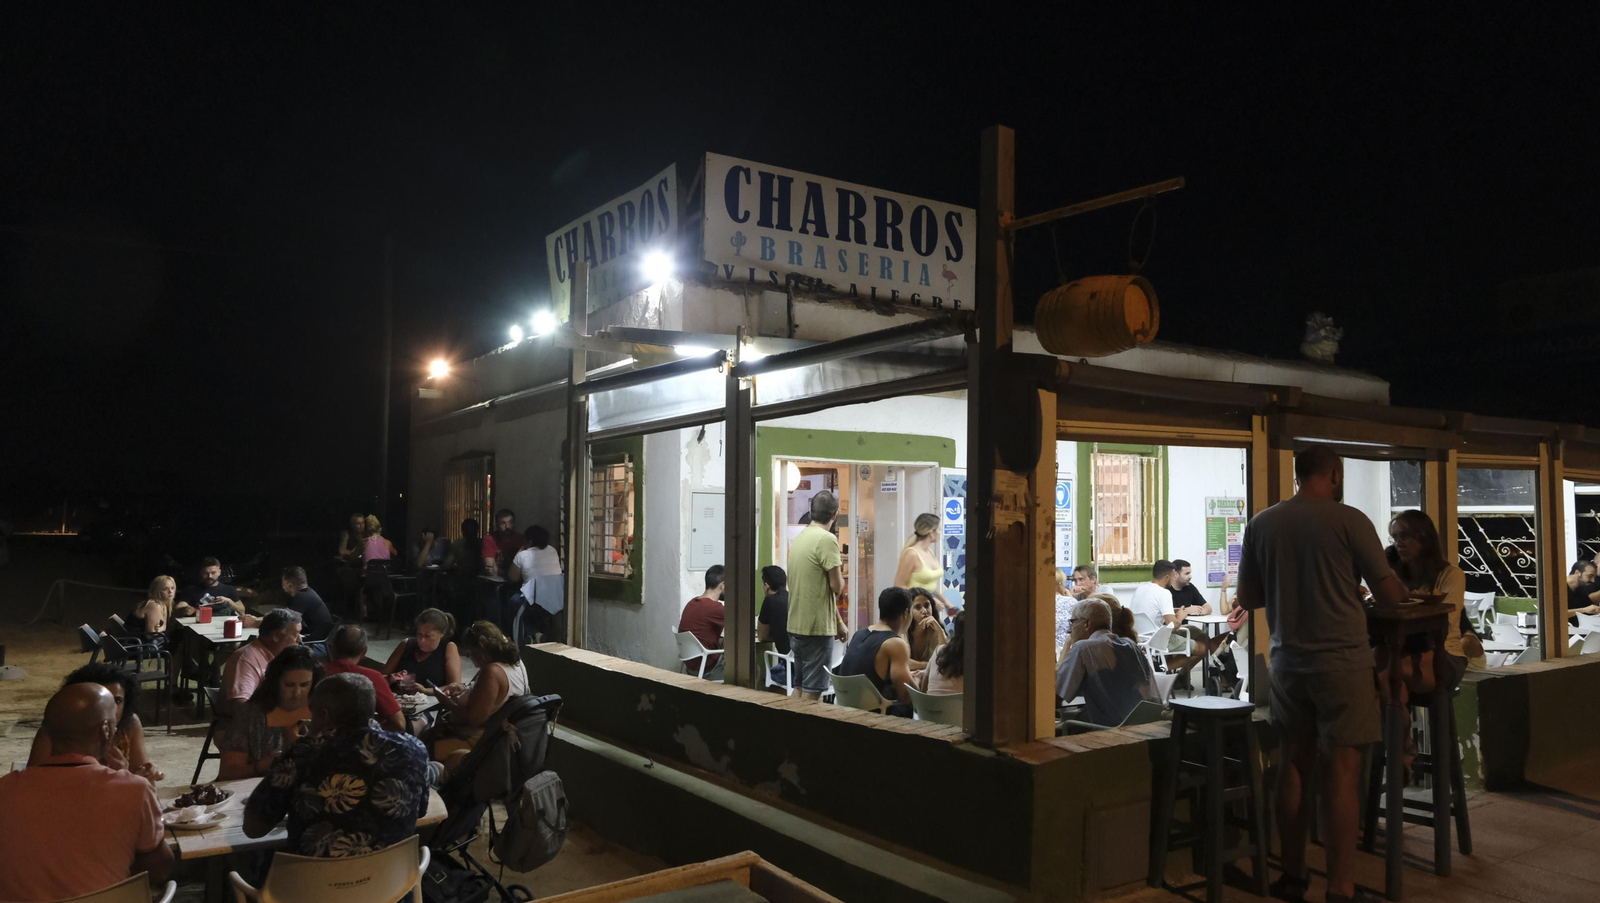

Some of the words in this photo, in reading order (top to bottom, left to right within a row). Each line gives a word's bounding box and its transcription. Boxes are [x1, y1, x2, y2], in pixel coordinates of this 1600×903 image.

[554, 176, 671, 284] CHARROS
[724, 165, 965, 263] CHARROS
[760, 235, 932, 287] BRASERIA
